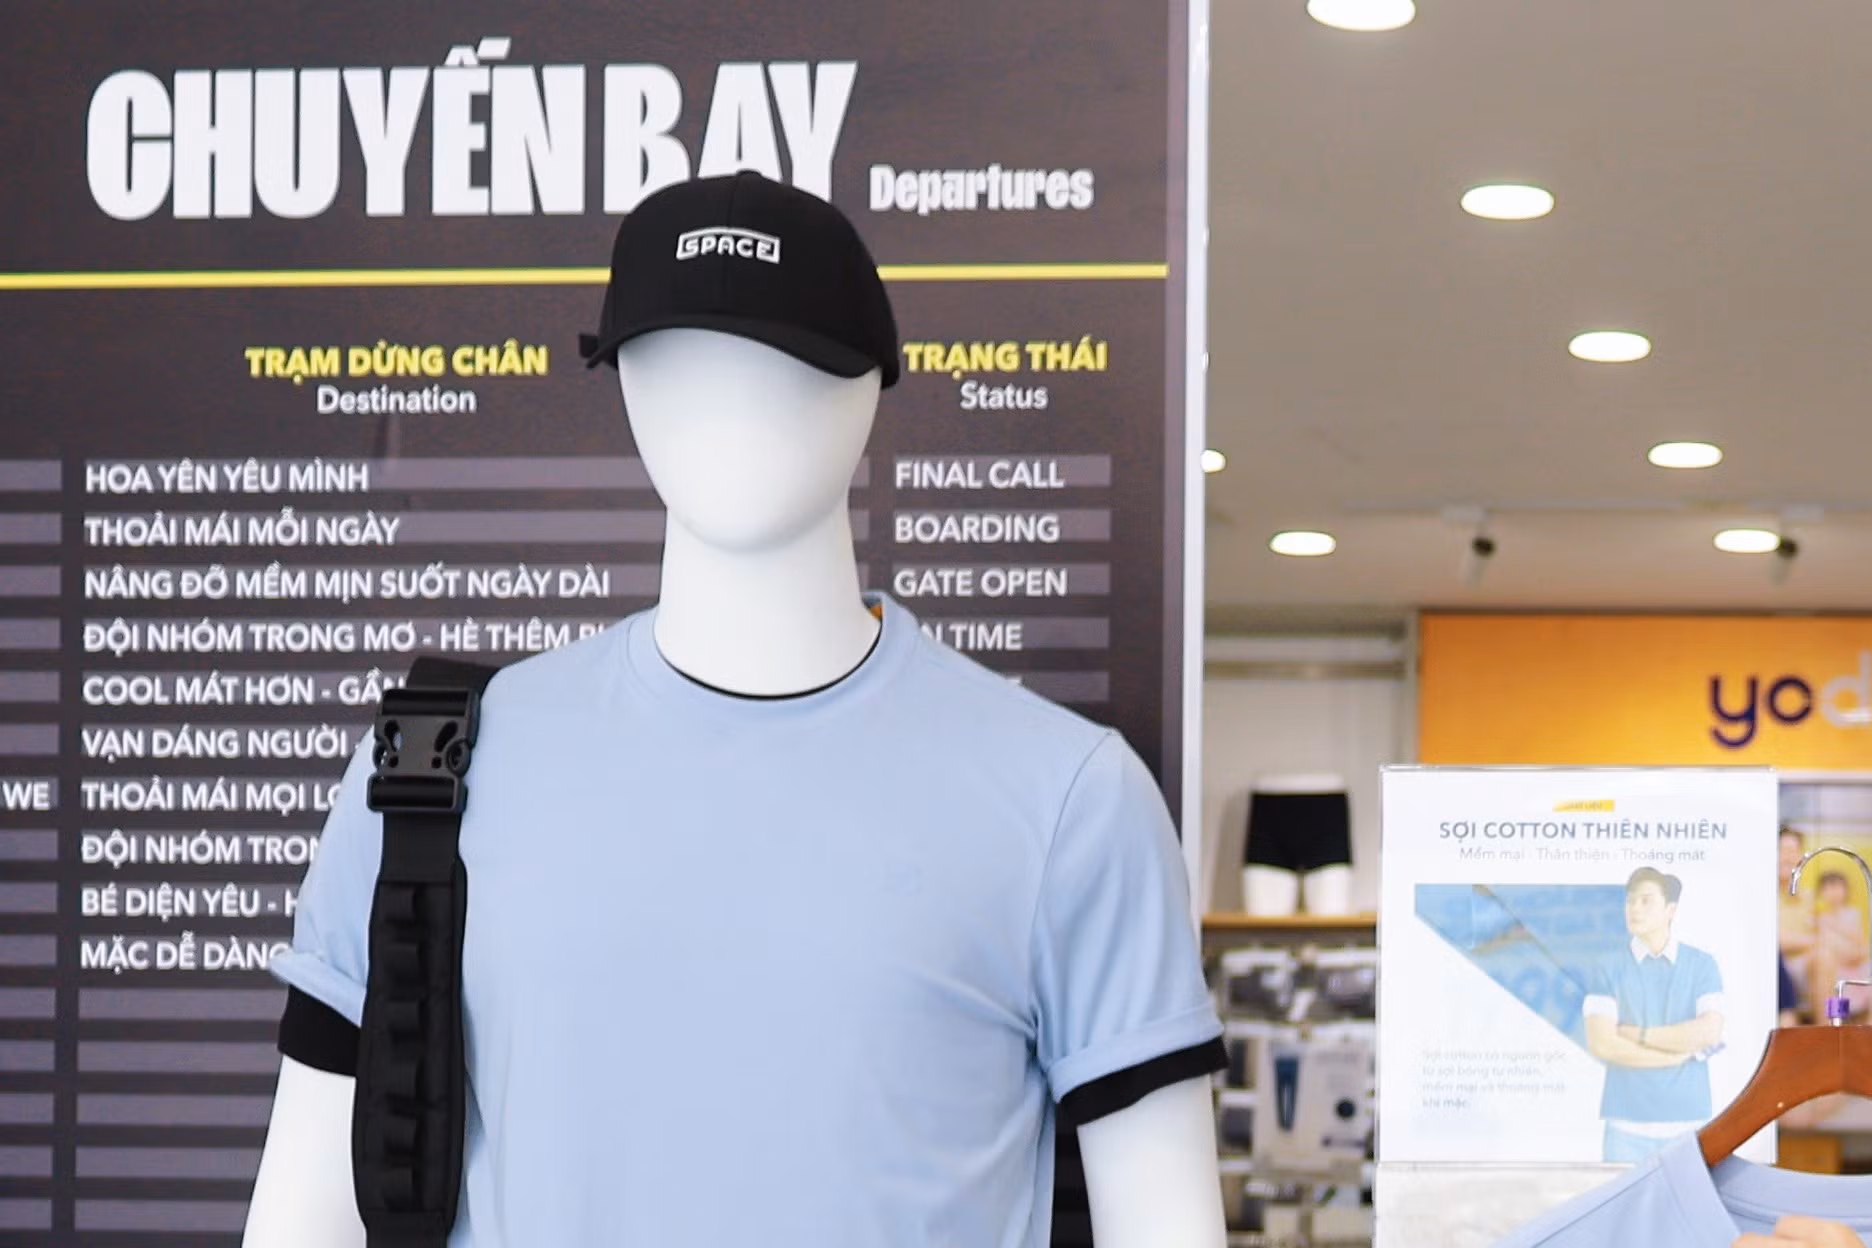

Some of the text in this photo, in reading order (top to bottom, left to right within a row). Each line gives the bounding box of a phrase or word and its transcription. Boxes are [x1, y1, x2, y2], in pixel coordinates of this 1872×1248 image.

[86, 36, 859, 220] CHUYẾN BAY
[869, 163, 1094, 216] Departures
[677, 230, 780, 264] SPACE
[245, 337, 549, 386] TRẠM DỪNG CHÂN
[902, 334, 1108, 381] TRẠNG THÁI
[317, 383, 477, 414] Destination
[960, 380, 1049, 410] Status
[85, 457, 369, 494] HOA YÊN YÊU MÌNH
[895, 459, 1066, 489] FINAL CALL
[84, 505, 400, 546] THOẢI MÁI MỖI NGÀY
[895, 513, 1061, 544] BOARDING
[84, 563, 174, 599] NÂNG
[314, 569, 372, 604] MỊN
[380, 560, 461, 599] SUỐT
[467, 561, 551, 598] NGÀY
[558, 561, 609, 598] DÀI
[894, 568, 1069, 597] GATE OPEN
[83, 616, 141, 658] ĐỘI
[147, 616, 243, 652] NHÓM
[249, 622, 355, 652] TRONG
[440, 616, 480, 651] HÈ
[486, 616, 570, 651] THÊM
[949, 622, 1023, 650] TIME
[82, 674, 169, 705] COOL
[175, 669, 239, 705] MÁT
[245, 674, 313, 705] HƠN
[81, 722, 348, 763] VẠN DÁNG NGƯỜI
[2, 780, 50, 811] WE
[81, 775, 174, 811] THOẢI
[182, 775, 238, 811] MÁI
[246, 781, 305, 817] MỌI
[81, 829, 137, 869] ĐỘI
[145, 829, 241, 864] NHÓM
[1439, 818, 1727, 843] SỢI COTTON THIÊN NHIÊN
[81, 882, 118, 917] BÉ
[125, 882, 196, 922] DIỆN
[202, 882, 259, 917] YÊU
[80, 935, 150, 975] MẶC
[156, 929, 197, 970] DỄ
